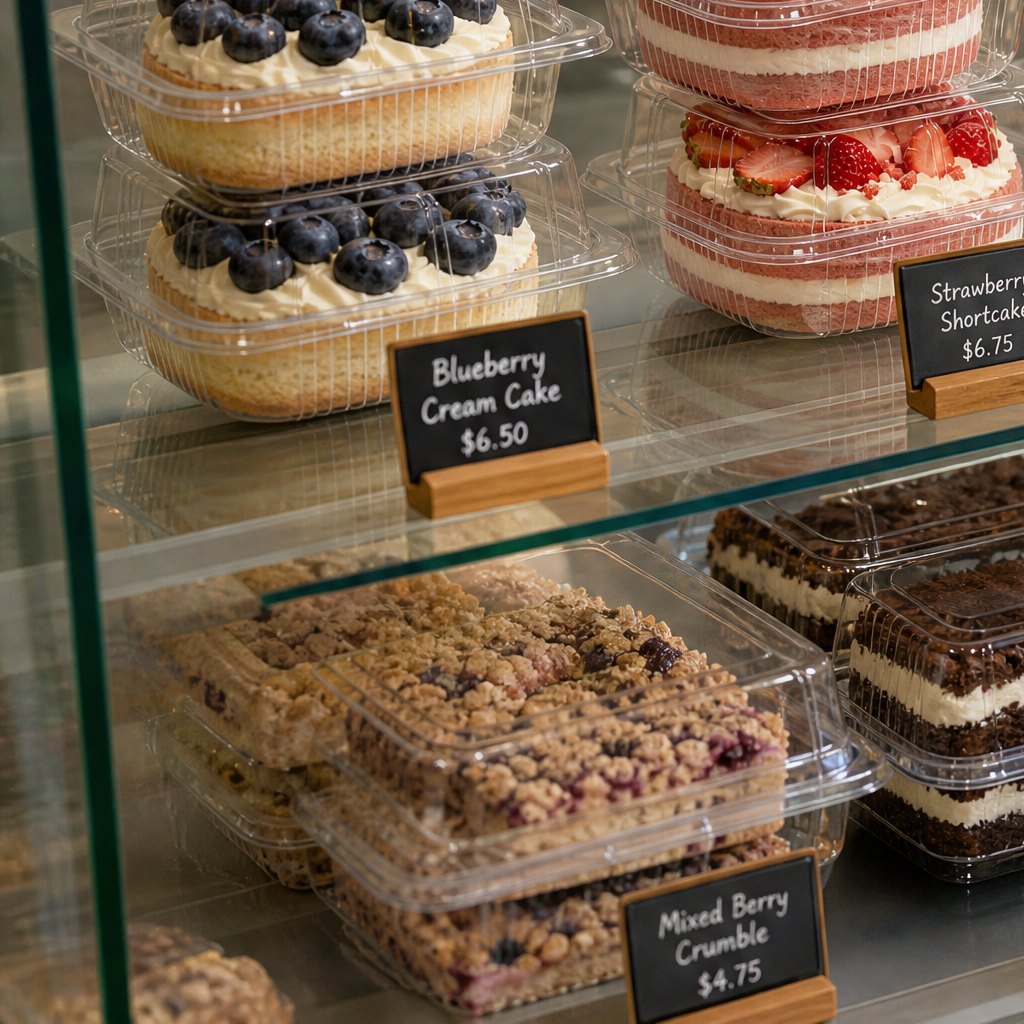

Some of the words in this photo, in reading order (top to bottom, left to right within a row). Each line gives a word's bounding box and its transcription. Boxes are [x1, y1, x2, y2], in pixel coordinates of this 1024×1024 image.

[962, 333, 1013, 362] $6.75
[432, 349, 546, 388] Blueberry
[421, 396, 497, 425] Cream
[504, 378, 562, 410] Cake
[461, 421, 529, 458] $6.50
[658, 896, 724, 940] Mixed
[732, 891, 788, 919] Berry
[675, 919, 770, 966] Crumble
[697, 958, 762, 999] $4.75
